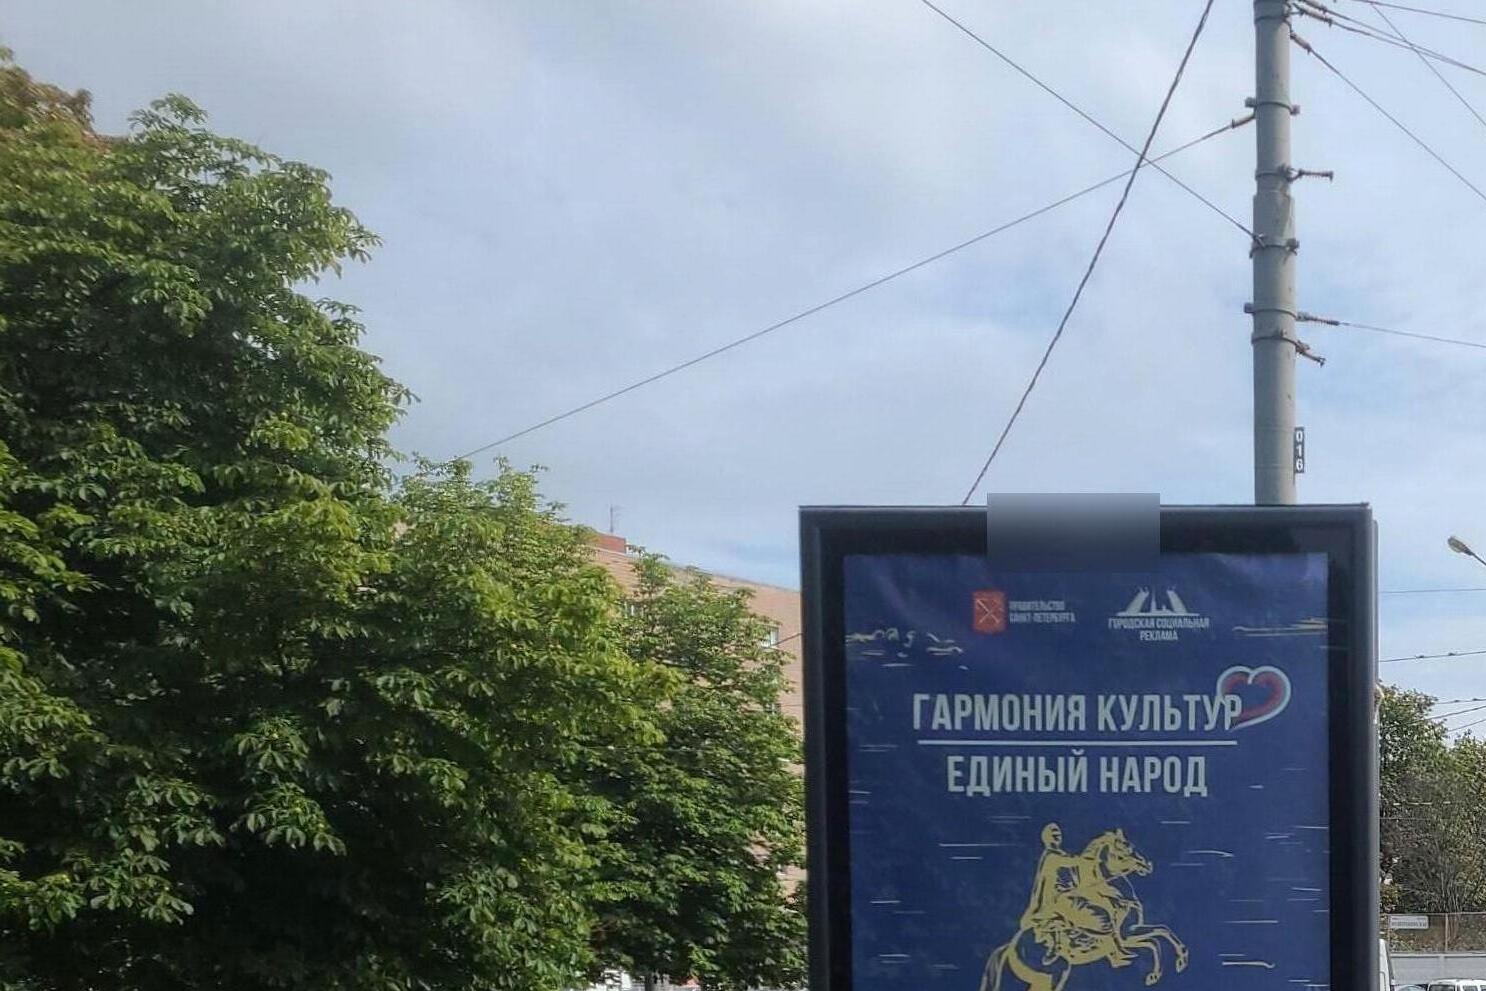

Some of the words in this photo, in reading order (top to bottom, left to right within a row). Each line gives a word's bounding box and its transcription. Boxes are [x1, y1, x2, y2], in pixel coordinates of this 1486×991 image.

[1295, 430, 1303, 471] 016
[1108, 617, 1155, 629] ГОРОДСКАЯ
[1156, 617, 1210, 629] СОЦИАЛЬНАЯ
[1140, 629, 1179, 641] РЕКЛАМА
[913, 693, 1087, 731] ГАРМОНИЯ
[1097, 694, 1243, 732] КУЛЬТУР
[947, 748, 1088, 797] ЕДИНЫЙ
[1099, 756, 1208, 797] НАРОД
